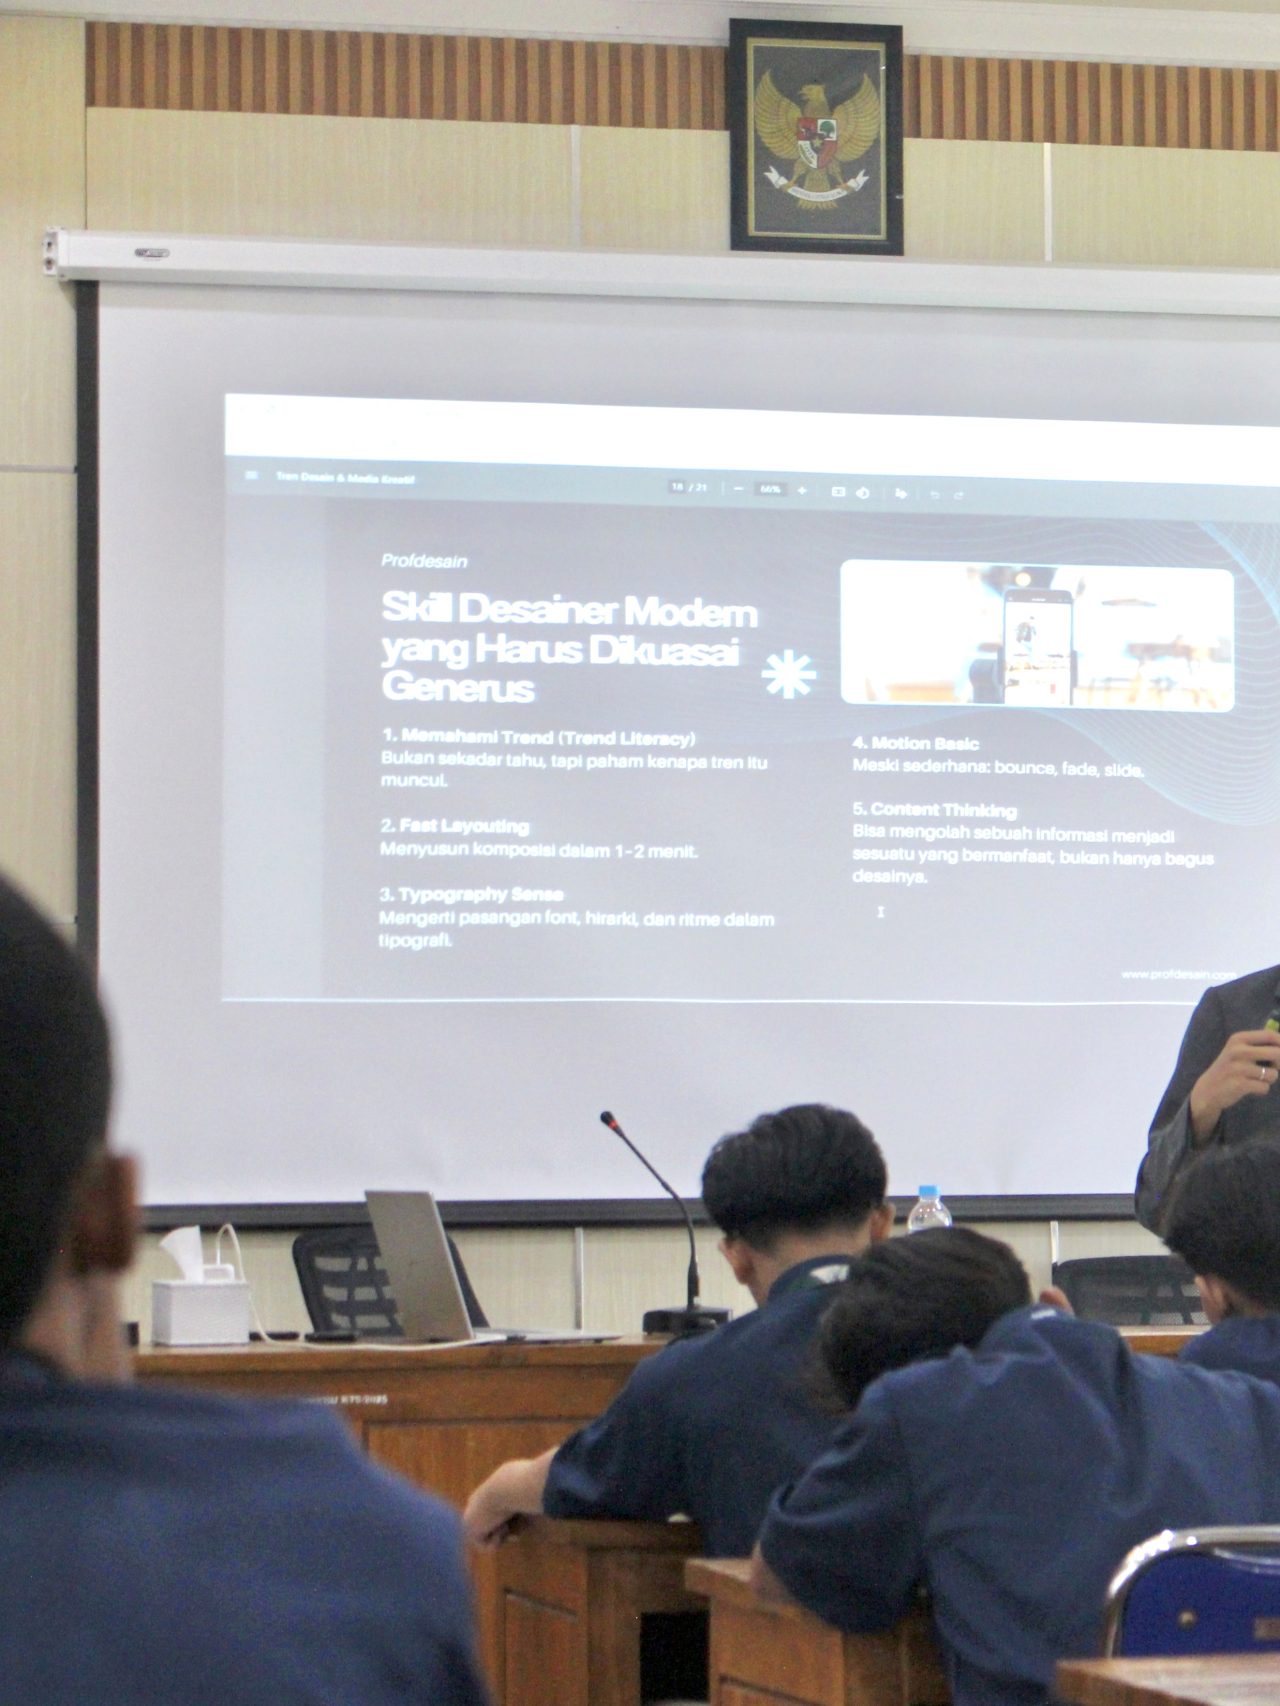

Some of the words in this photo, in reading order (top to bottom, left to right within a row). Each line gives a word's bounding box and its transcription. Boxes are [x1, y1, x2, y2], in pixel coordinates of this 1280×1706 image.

[382, 553, 467, 570] Profdesain
[382, 591, 453, 622] Skill
[460, 594, 619, 624] Desainer
[625, 596, 758, 628] Modern
[381, 635, 469, 669] yang
[476, 635, 583, 665] Harus
[590, 636, 739, 667] Dikuasai
[382, 671, 535, 703] Generus
[383, 729, 397, 744] 1.
[402, 729, 498, 745] Memahami
[502, 731, 554, 745] Trend
[559, 732, 616, 746] (Trend
[620, 732, 696, 747] Literacy)
[853, 737, 867, 749] 4.
[872, 737, 930, 750] Motion
[935, 737, 979, 751] Basic
[382, 751, 434, 765] Bukan
[439, 752, 502, 767] sekadar
[506, 754, 546, 769] tahu,
[551, 755, 582, 770] tapi
[587, 755, 643, 771] paham
[647, 755, 707, 771] kenapa
[711, 757, 743, 769] tren
[747, 757, 767, 770] itu
[853, 759, 898, 773] Meski
[903, 760, 990, 774] sederhana:
[995, 761, 1058, 776] bounce,
[1062, 763, 1100, 777] fade,
[1105, 763, 1144, 778] slide.
[381, 774, 448, 787] muncul.
[853, 803, 867, 815] 5.
[871, 803, 939, 817] Content
[944, 803, 1017, 821] Thinking
[380, 820, 395, 833] 2.
[400, 819, 437, 834] Fast
[442, 819, 529, 837] Layouting
[853, 824, 886, 838] Bisa
[890, 825, 969, 842] mengolah
[974, 826, 1032, 841] sebuah
[1036, 827, 1108, 842] informasi
[1112, 829, 1174, 846] menjadi
[380, 842, 468, 858] Menyusun
[473, 843, 555, 859] komposisi
[559, 844, 609, 857] dalam
[649, 845, 698, 859] menit.
[853, 848, 914, 861] sesuatu
[918, 849, 958, 865] yang
[963, 849, 1055, 865] bermanfaat,
[1060, 851, 1109, 865] bukan
[1114, 852, 1161, 868] hanya
[1165, 852, 1214, 869] bagus
[853, 870, 927, 885] desainya.
[380, 888, 394, 901] 3.
[398, 888, 508, 903] Typography
[512, 888, 564, 902] Sense
[379, 911, 455, 927] Mengerti
[460, 911, 541, 928] pasangan
[545, 912, 580, 927] font,
[586, 913, 639, 928] hirarki,
[644, 913, 674, 926] dan
[679, 913, 719, 927] ritme
[724, 913, 774, 927] dalam
[379, 934, 452, 951] tipografi.
